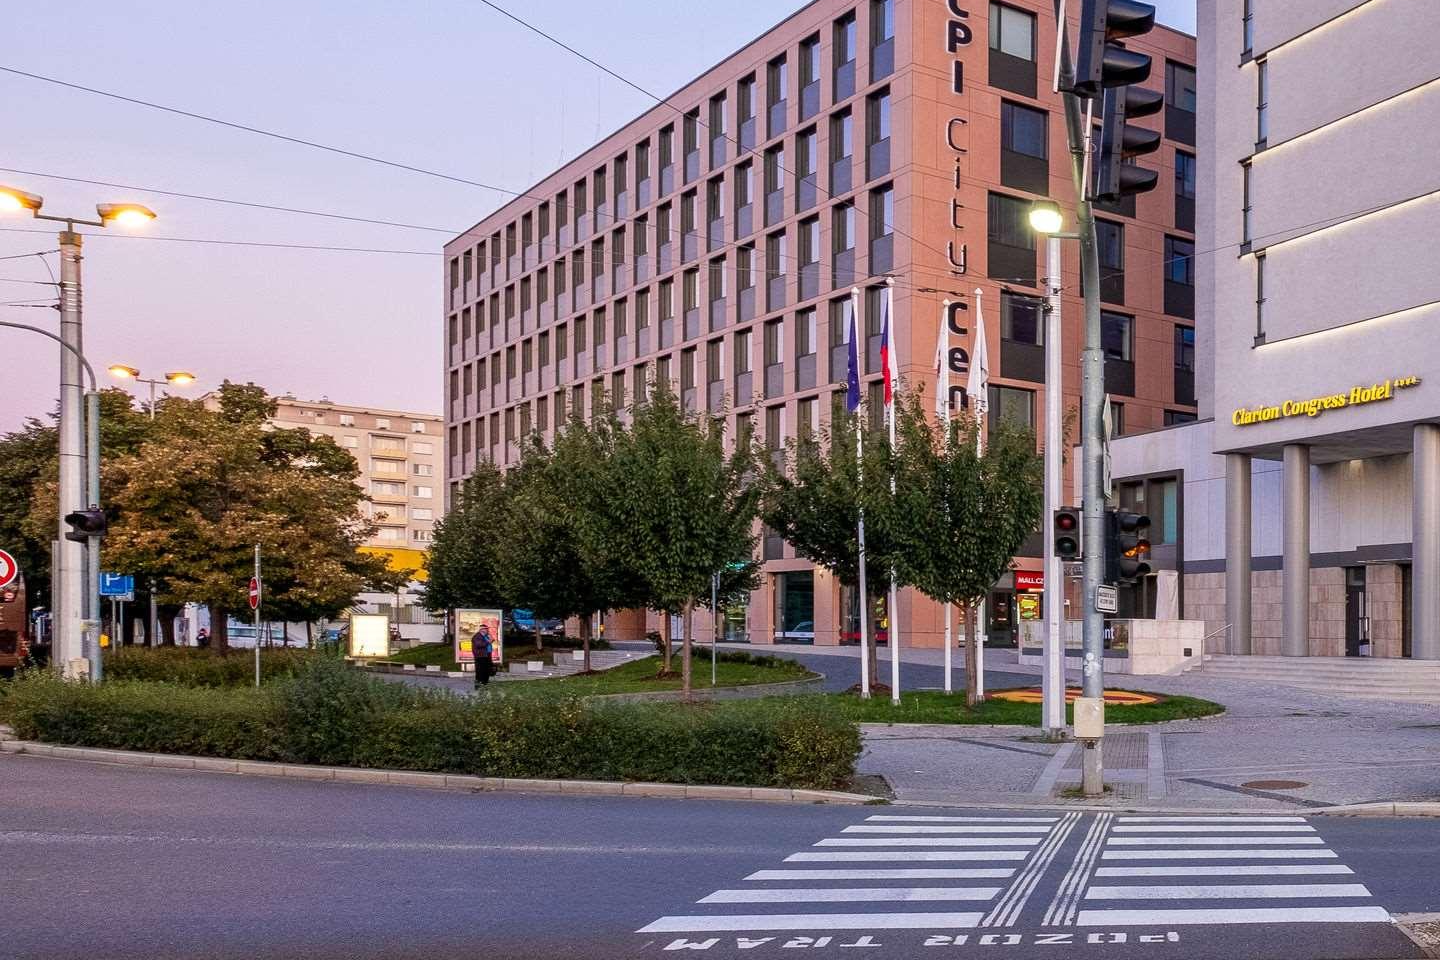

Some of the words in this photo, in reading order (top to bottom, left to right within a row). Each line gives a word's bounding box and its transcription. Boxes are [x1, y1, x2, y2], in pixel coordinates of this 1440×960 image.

[946, 117, 967, 275] City
[1232, 404, 1280, 426] Clarion
[1282, 393, 1346, 417] Congress
[1349, 380, 1391, 405] Hotel
[663, 935, 882, 951] TRAM
